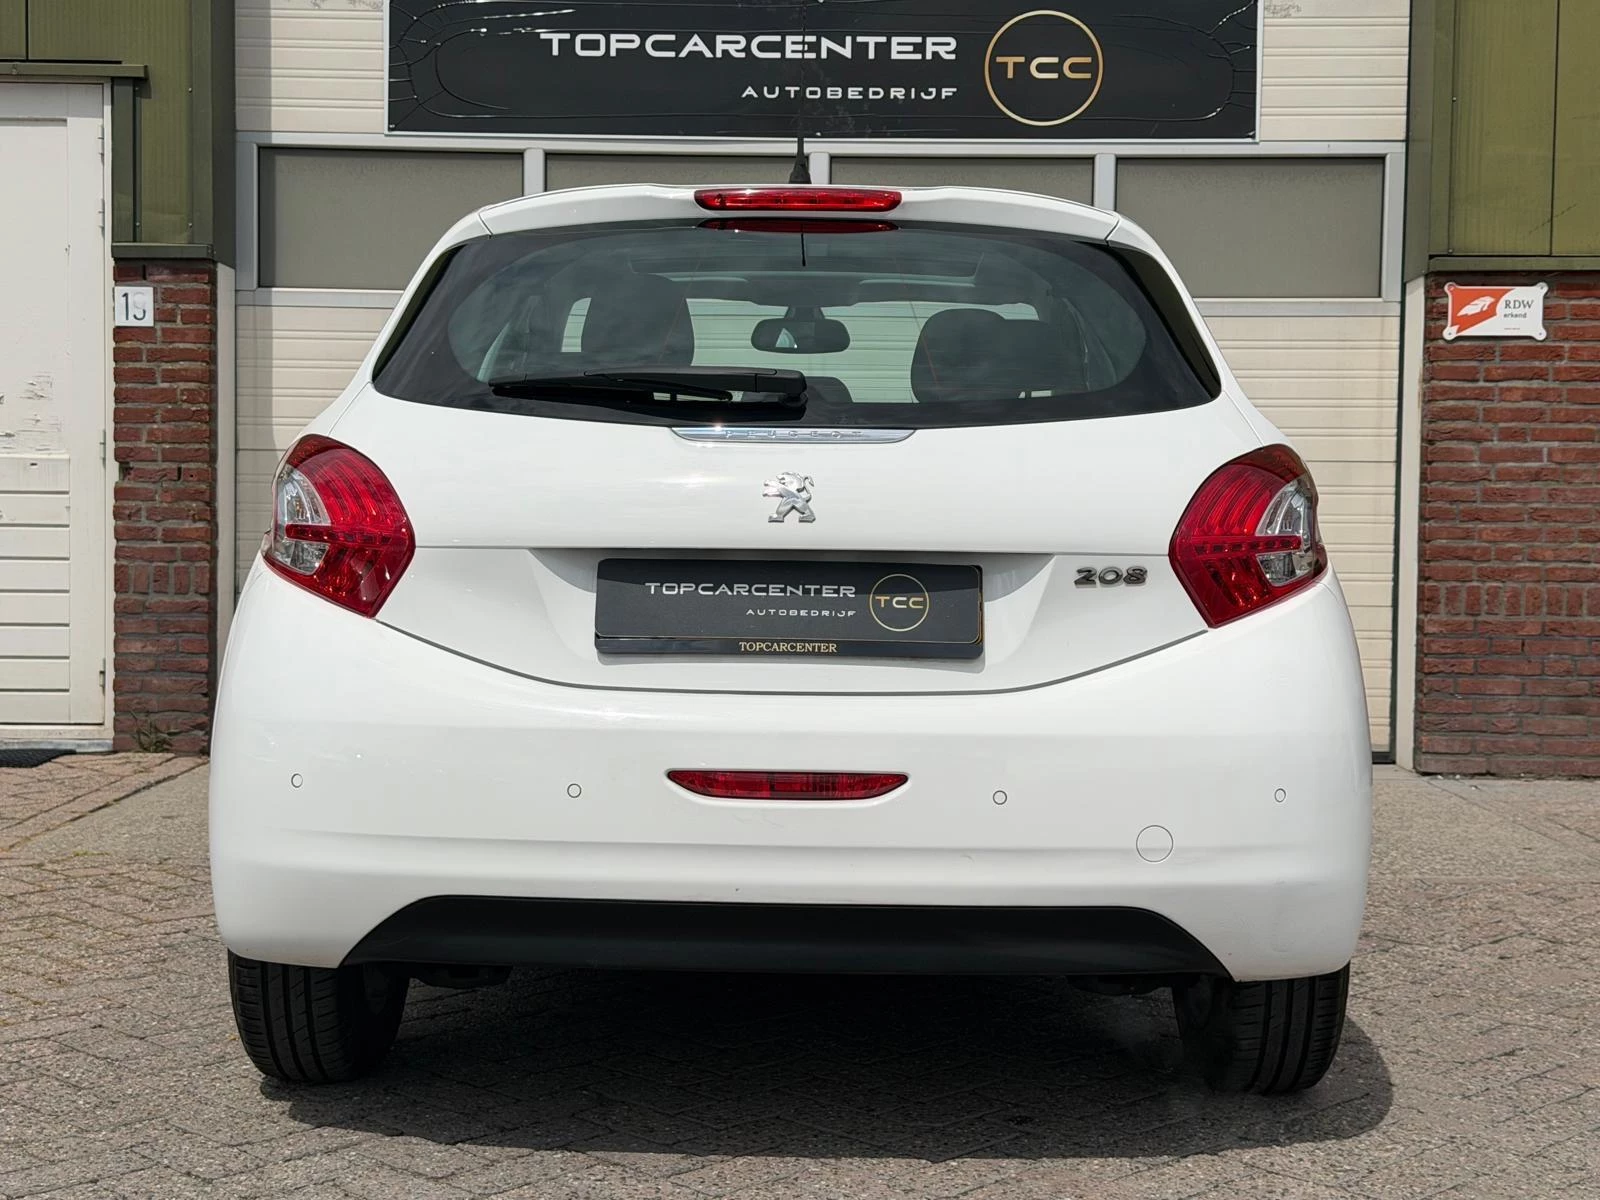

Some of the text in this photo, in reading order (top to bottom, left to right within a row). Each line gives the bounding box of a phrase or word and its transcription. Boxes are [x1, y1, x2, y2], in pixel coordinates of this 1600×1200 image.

[539, 32, 958, 60] TOPCARCENTER
[995, 56, 1092, 79] TCC
[741, 85, 958, 99] AUTOBEDRIJF
[1504, 299, 1534, 309] RDW
[1073, 565, 1148, 588] 208
[644, 582, 856, 598] TOPCARCENTER
[875, 594, 924, 610] TCC
[745, 608, 856, 617] AUTOBEDRIJF
[738, 640, 838, 654] TOPCARCENTER
